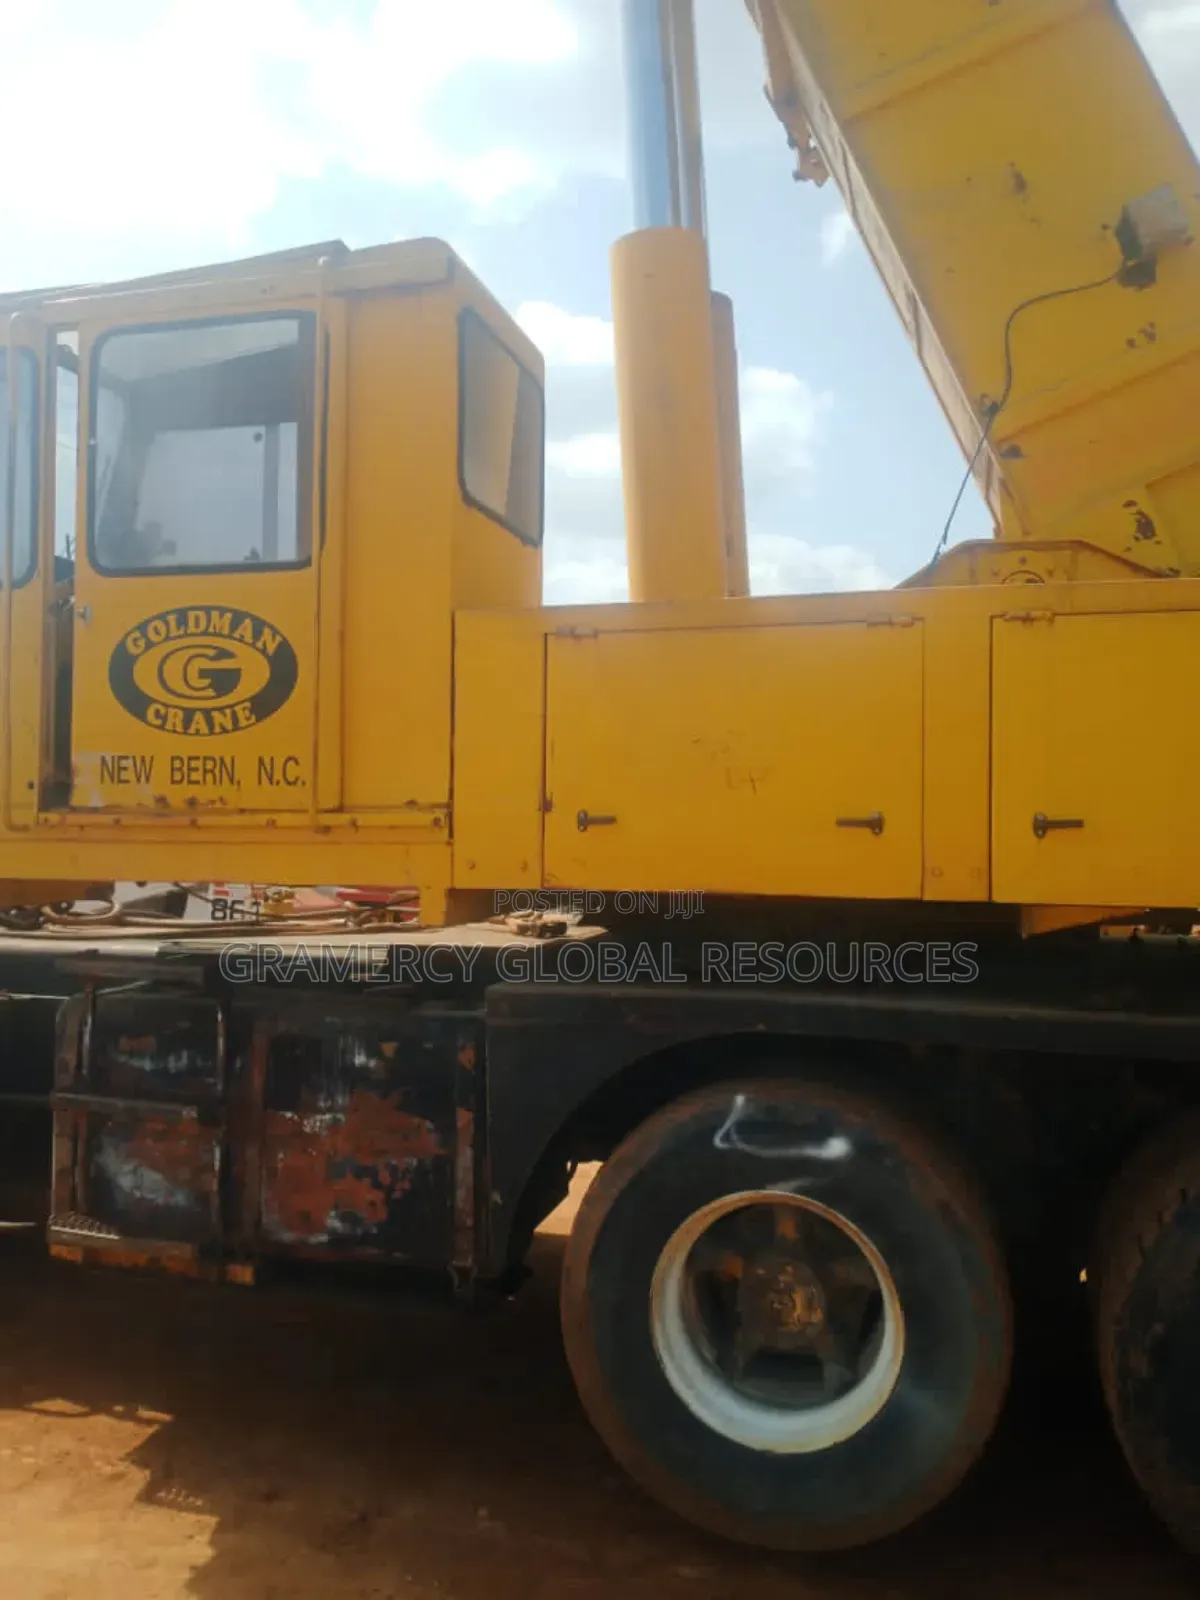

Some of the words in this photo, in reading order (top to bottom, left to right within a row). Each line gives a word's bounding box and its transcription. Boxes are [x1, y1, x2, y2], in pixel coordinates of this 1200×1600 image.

[125, 610, 283, 656] GOLDMAN
[146, 701, 256, 734] CRANE
[100, 755, 154, 785] NEW
[170, 755, 241, 791] BERN,
[257, 756, 307, 787] N.C.
